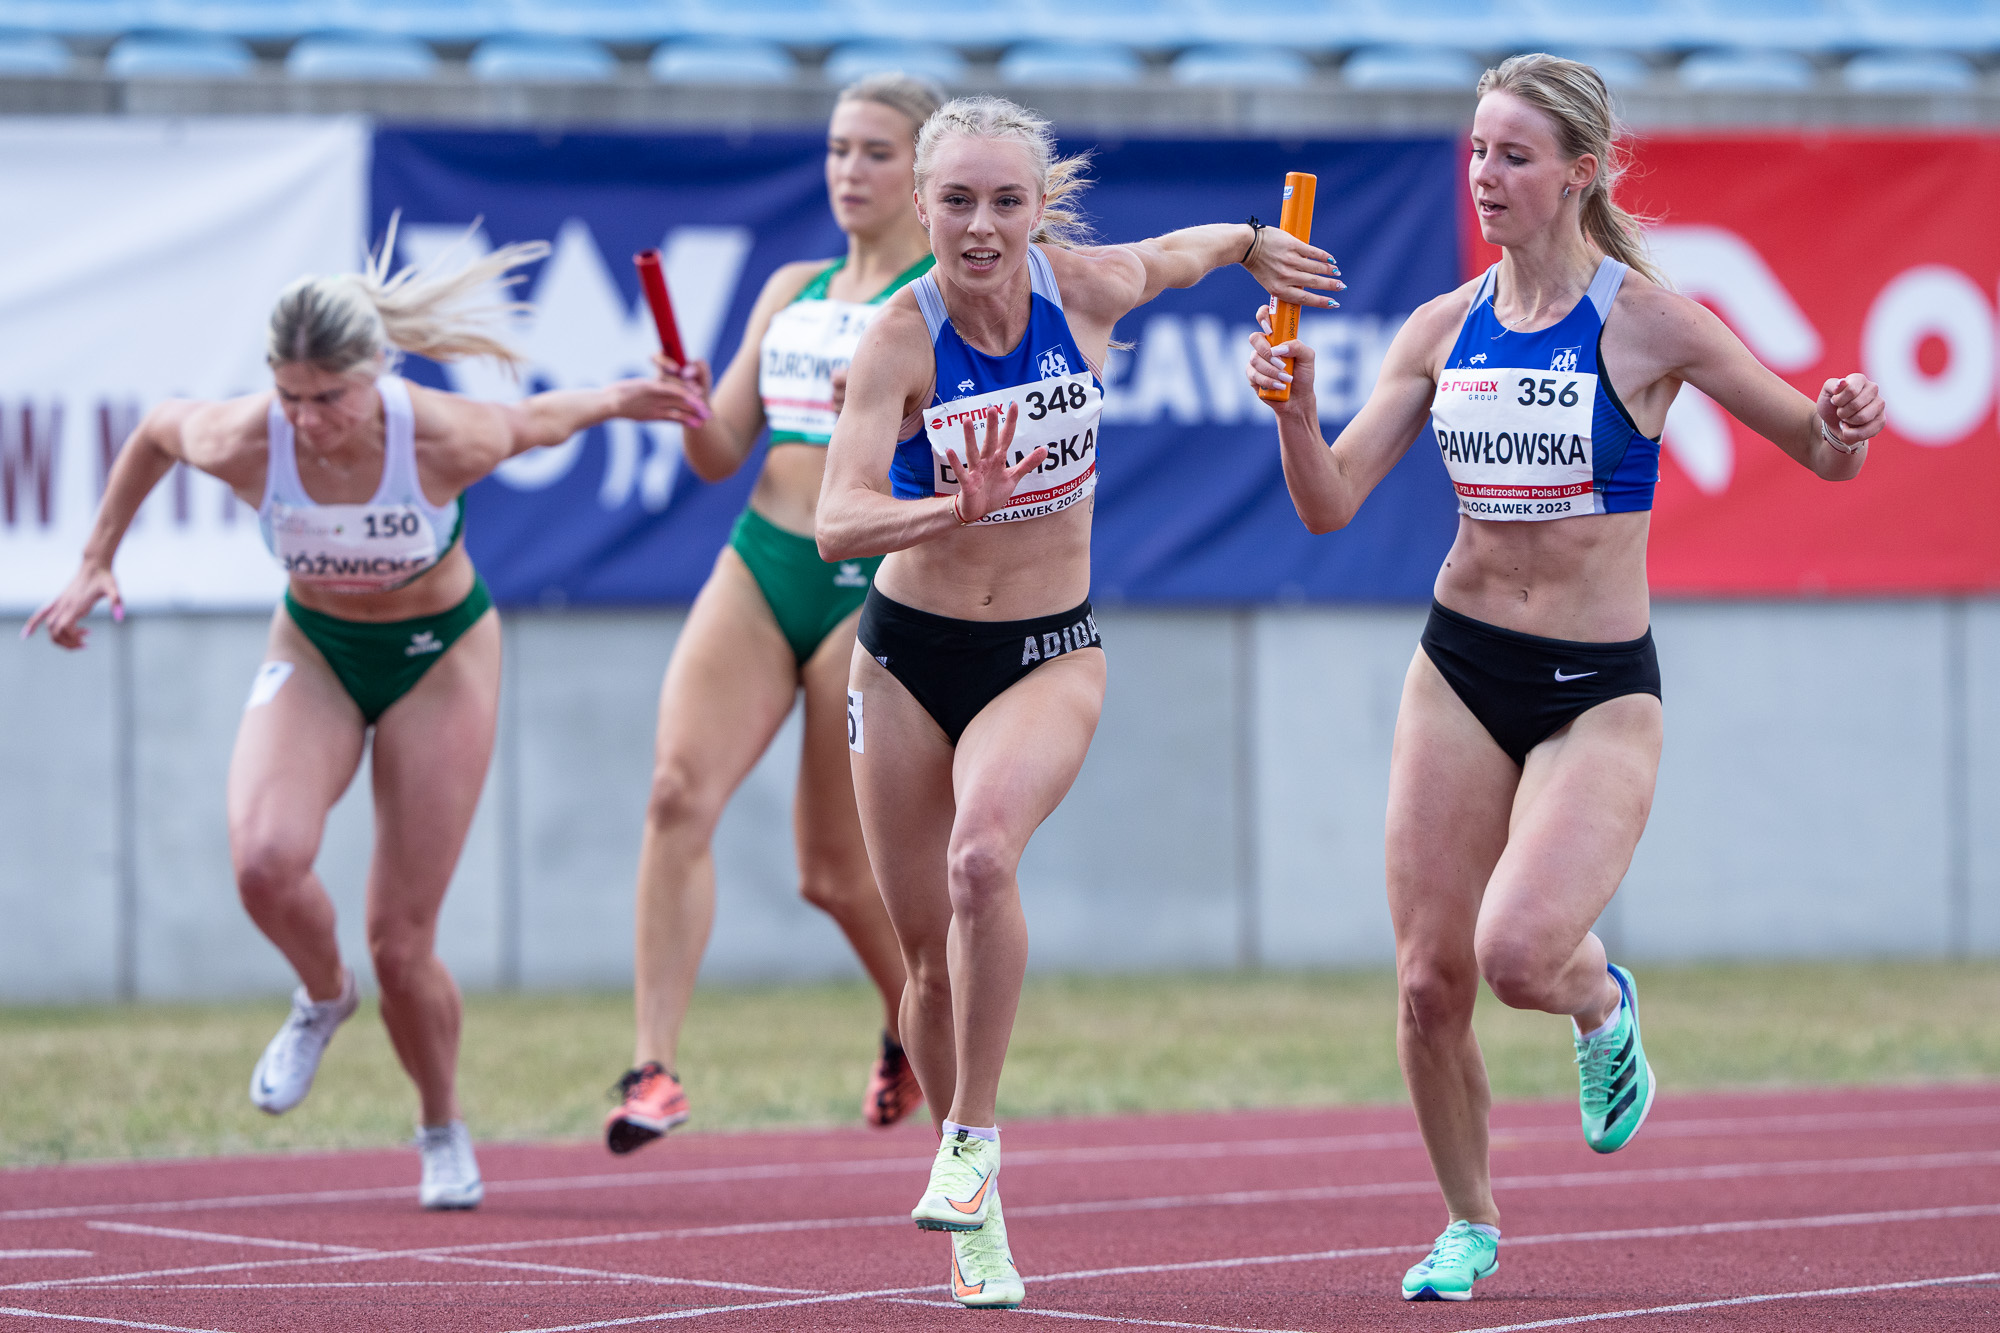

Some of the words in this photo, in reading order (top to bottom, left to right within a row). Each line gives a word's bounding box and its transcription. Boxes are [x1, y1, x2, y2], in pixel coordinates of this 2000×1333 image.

[1025, 382, 1087, 421] 348
[1517, 377, 1579, 408] 356
[973, 417, 1007, 432] GRP
[1438, 429, 1586, 466] PAWŁOWSKA
[1052, 479, 1078, 497] Polski
[1078, 469, 1091, 485] U23
[1459, 485, 1475, 496] PZLA
[1476, 485, 1529, 497] Mistrzostwa
[1531, 486, 1561, 497] Polski
[1563, 485, 1582, 496] U23
[1056, 488, 1083, 510] 2023
[1536, 501, 1571, 514] 2023
[364, 512, 420, 539] 150
